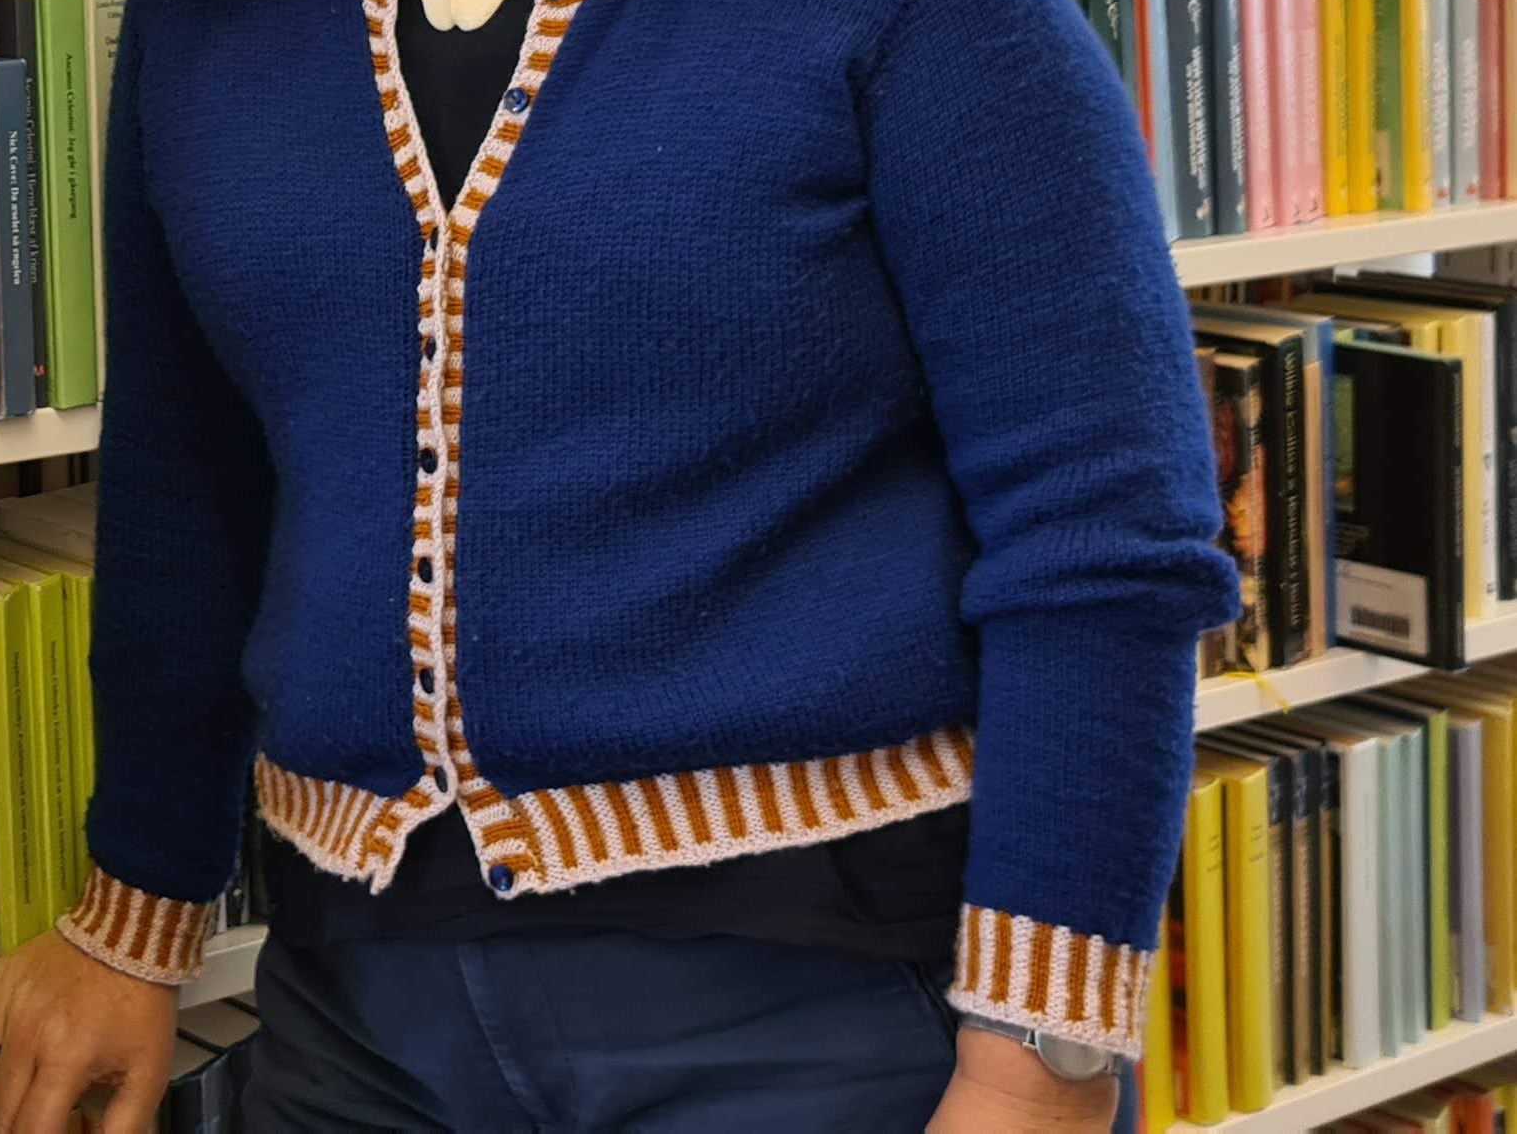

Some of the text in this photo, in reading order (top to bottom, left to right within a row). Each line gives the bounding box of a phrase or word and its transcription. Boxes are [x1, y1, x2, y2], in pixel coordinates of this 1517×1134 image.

[66, 53, 75, 89] Ascanio
[67, 91, 77, 133] Celestini:
[8, 130, 19, 154] Nick
[66, 137, 77, 154] Jeg
[9, 155, 20, 185] Cave:
[11, 248, 23, 285] engelen
